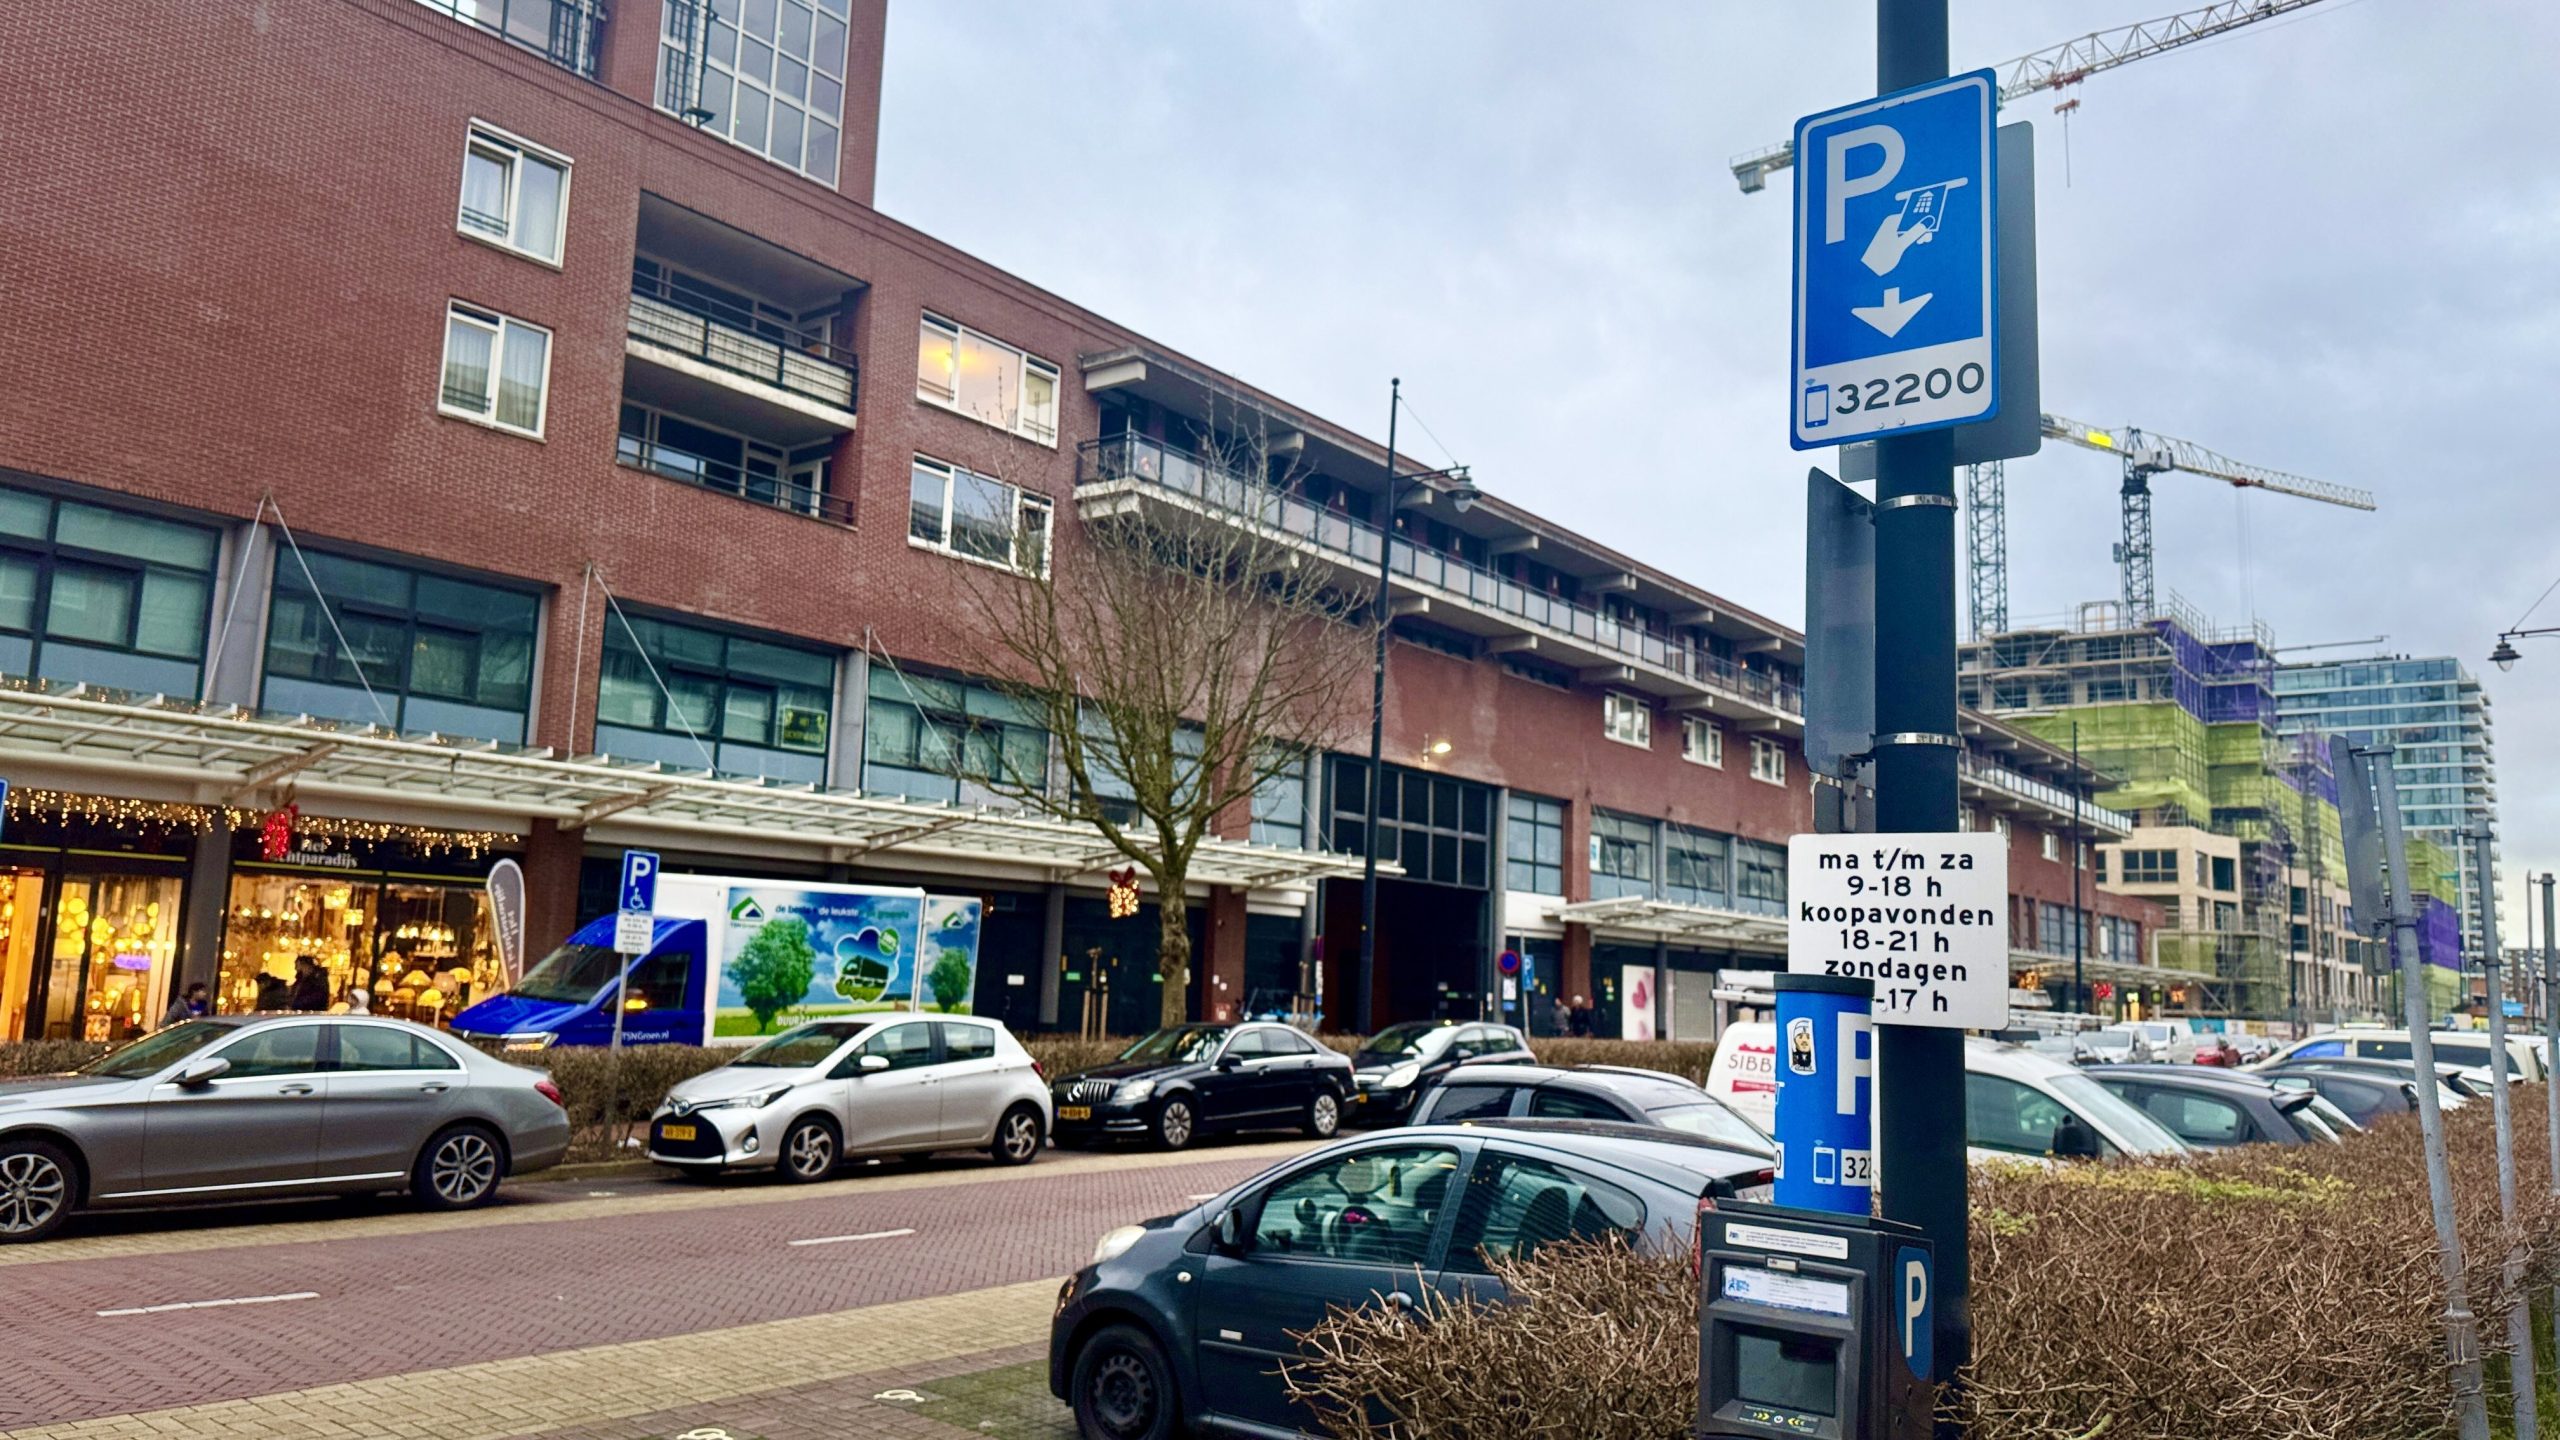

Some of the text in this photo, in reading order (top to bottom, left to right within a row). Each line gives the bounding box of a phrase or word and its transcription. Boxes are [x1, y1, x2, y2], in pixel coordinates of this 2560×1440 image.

[1826, 124, 1906, 245] P
[1835, 362, 1985, 415] 32200
[629, 856, 651, 887] P
[1819, 848, 1973, 871] ma t/m za
[1847, 875, 1942, 897] 9-18 h
[818, 906, 829, 916] de
[831, 906, 859, 917] leukste
[1801, 901, 1994, 926] koopavonden
[1840, 929, 1949, 952] 18-21 h
[1825, 957, 1968, 987] zondagen
[1872, 988, 1948, 1012] -17 h
[1728, 1054, 1773, 1073] SIBB
[1905, 1260, 1927, 1358] P
